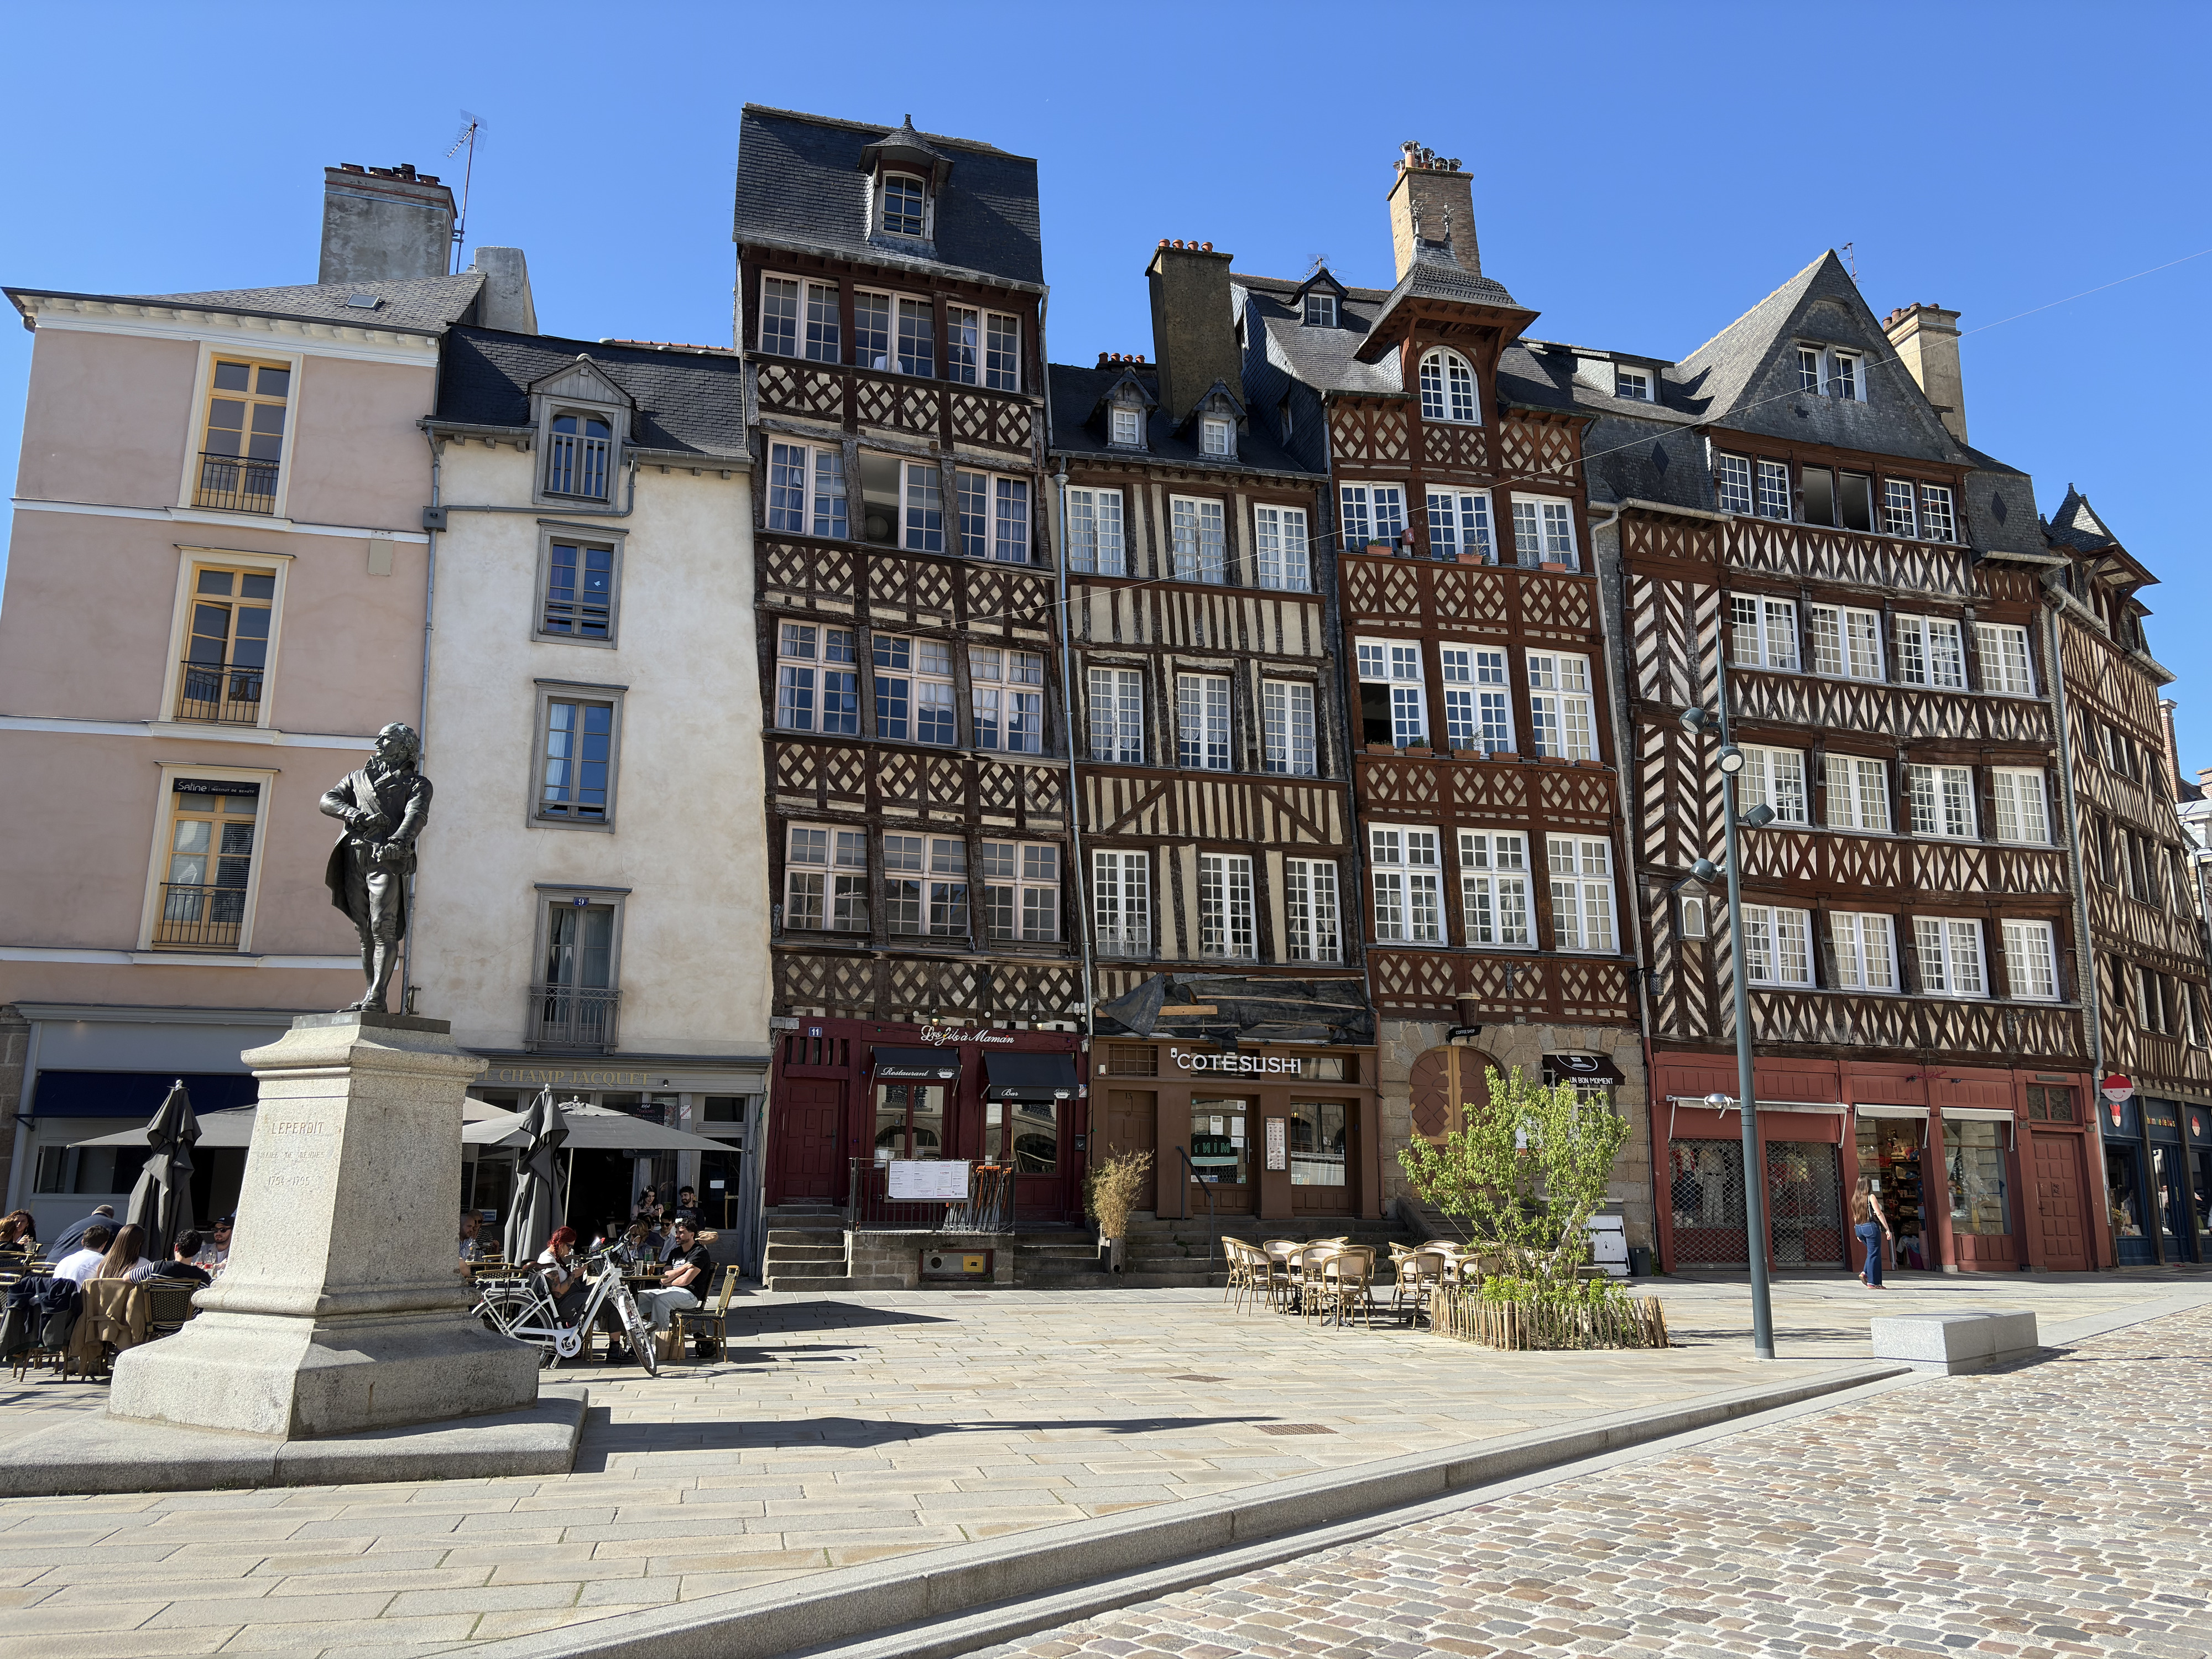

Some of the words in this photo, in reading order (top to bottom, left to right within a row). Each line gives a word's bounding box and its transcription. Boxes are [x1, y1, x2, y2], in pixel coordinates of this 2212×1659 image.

[178, 781, 207, 792] Satine
[920, 1025, 941, 1041] Les
[935, 1027, 958, 1046] fils
[957, 1031, 968, 1041] à
[968, 1029, 1014, 1044] Maman
[499, 1068, 565, 1083] CHAMP
[568, 1071, 651, 1087] JACQUET
[880, 1067, 928, 1077] Restaurant
[1001, 1088, 1019, 1097] Bar
[272, 1122, 324, 1134] LEPERDIT
